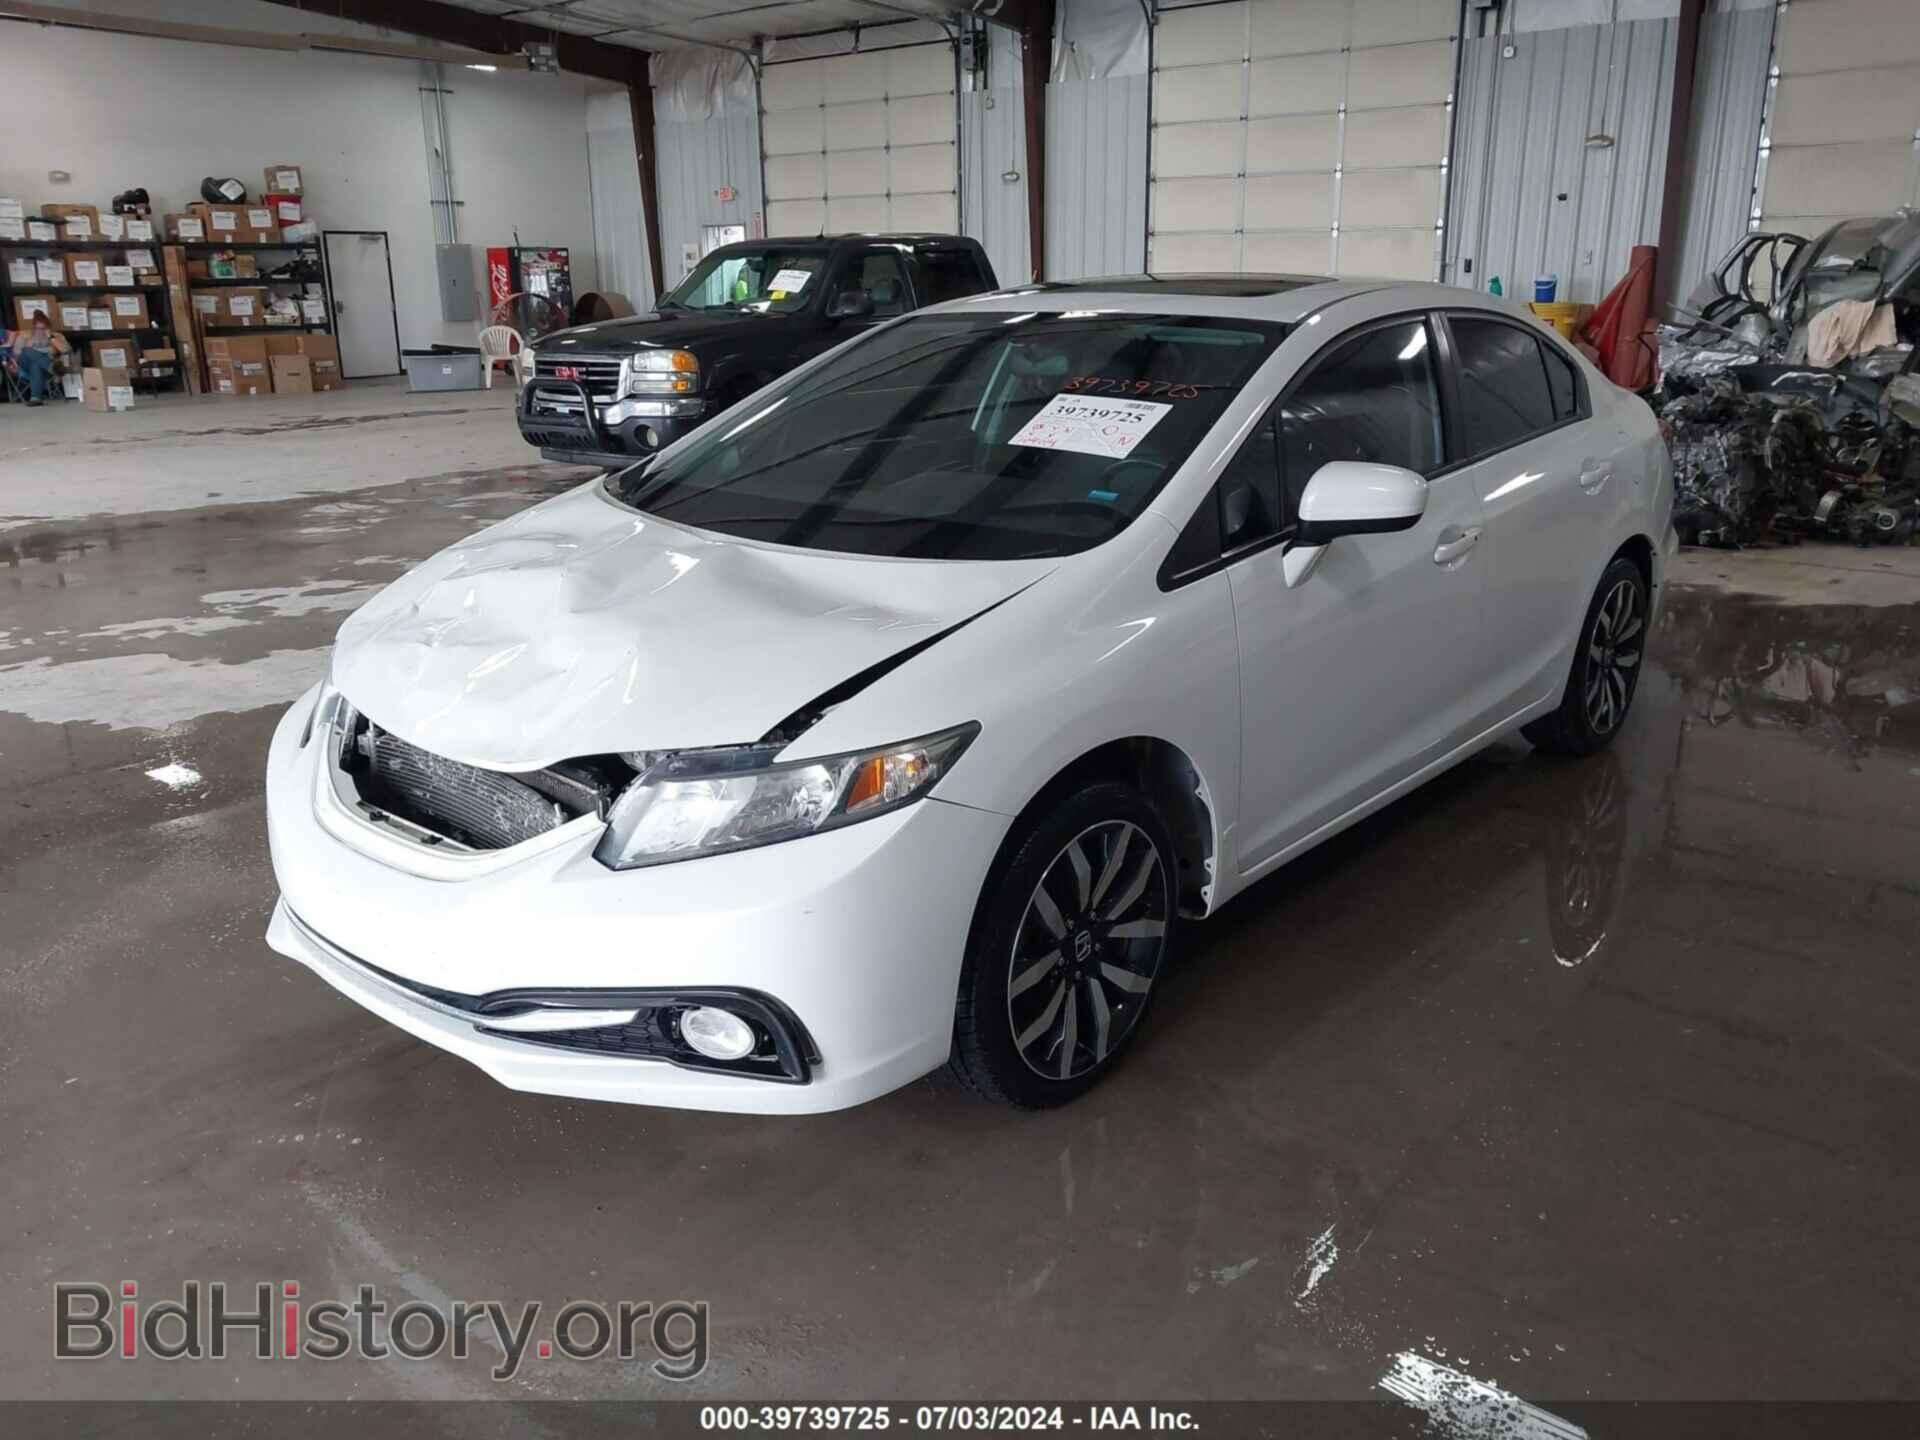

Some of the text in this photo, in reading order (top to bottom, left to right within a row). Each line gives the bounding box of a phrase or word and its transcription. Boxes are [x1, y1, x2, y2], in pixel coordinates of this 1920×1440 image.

[554, 367, 587, 382] GMC
[1064, 376, 1213, 399] 39739725
[1052, 404, 1147, 424] 39739725
